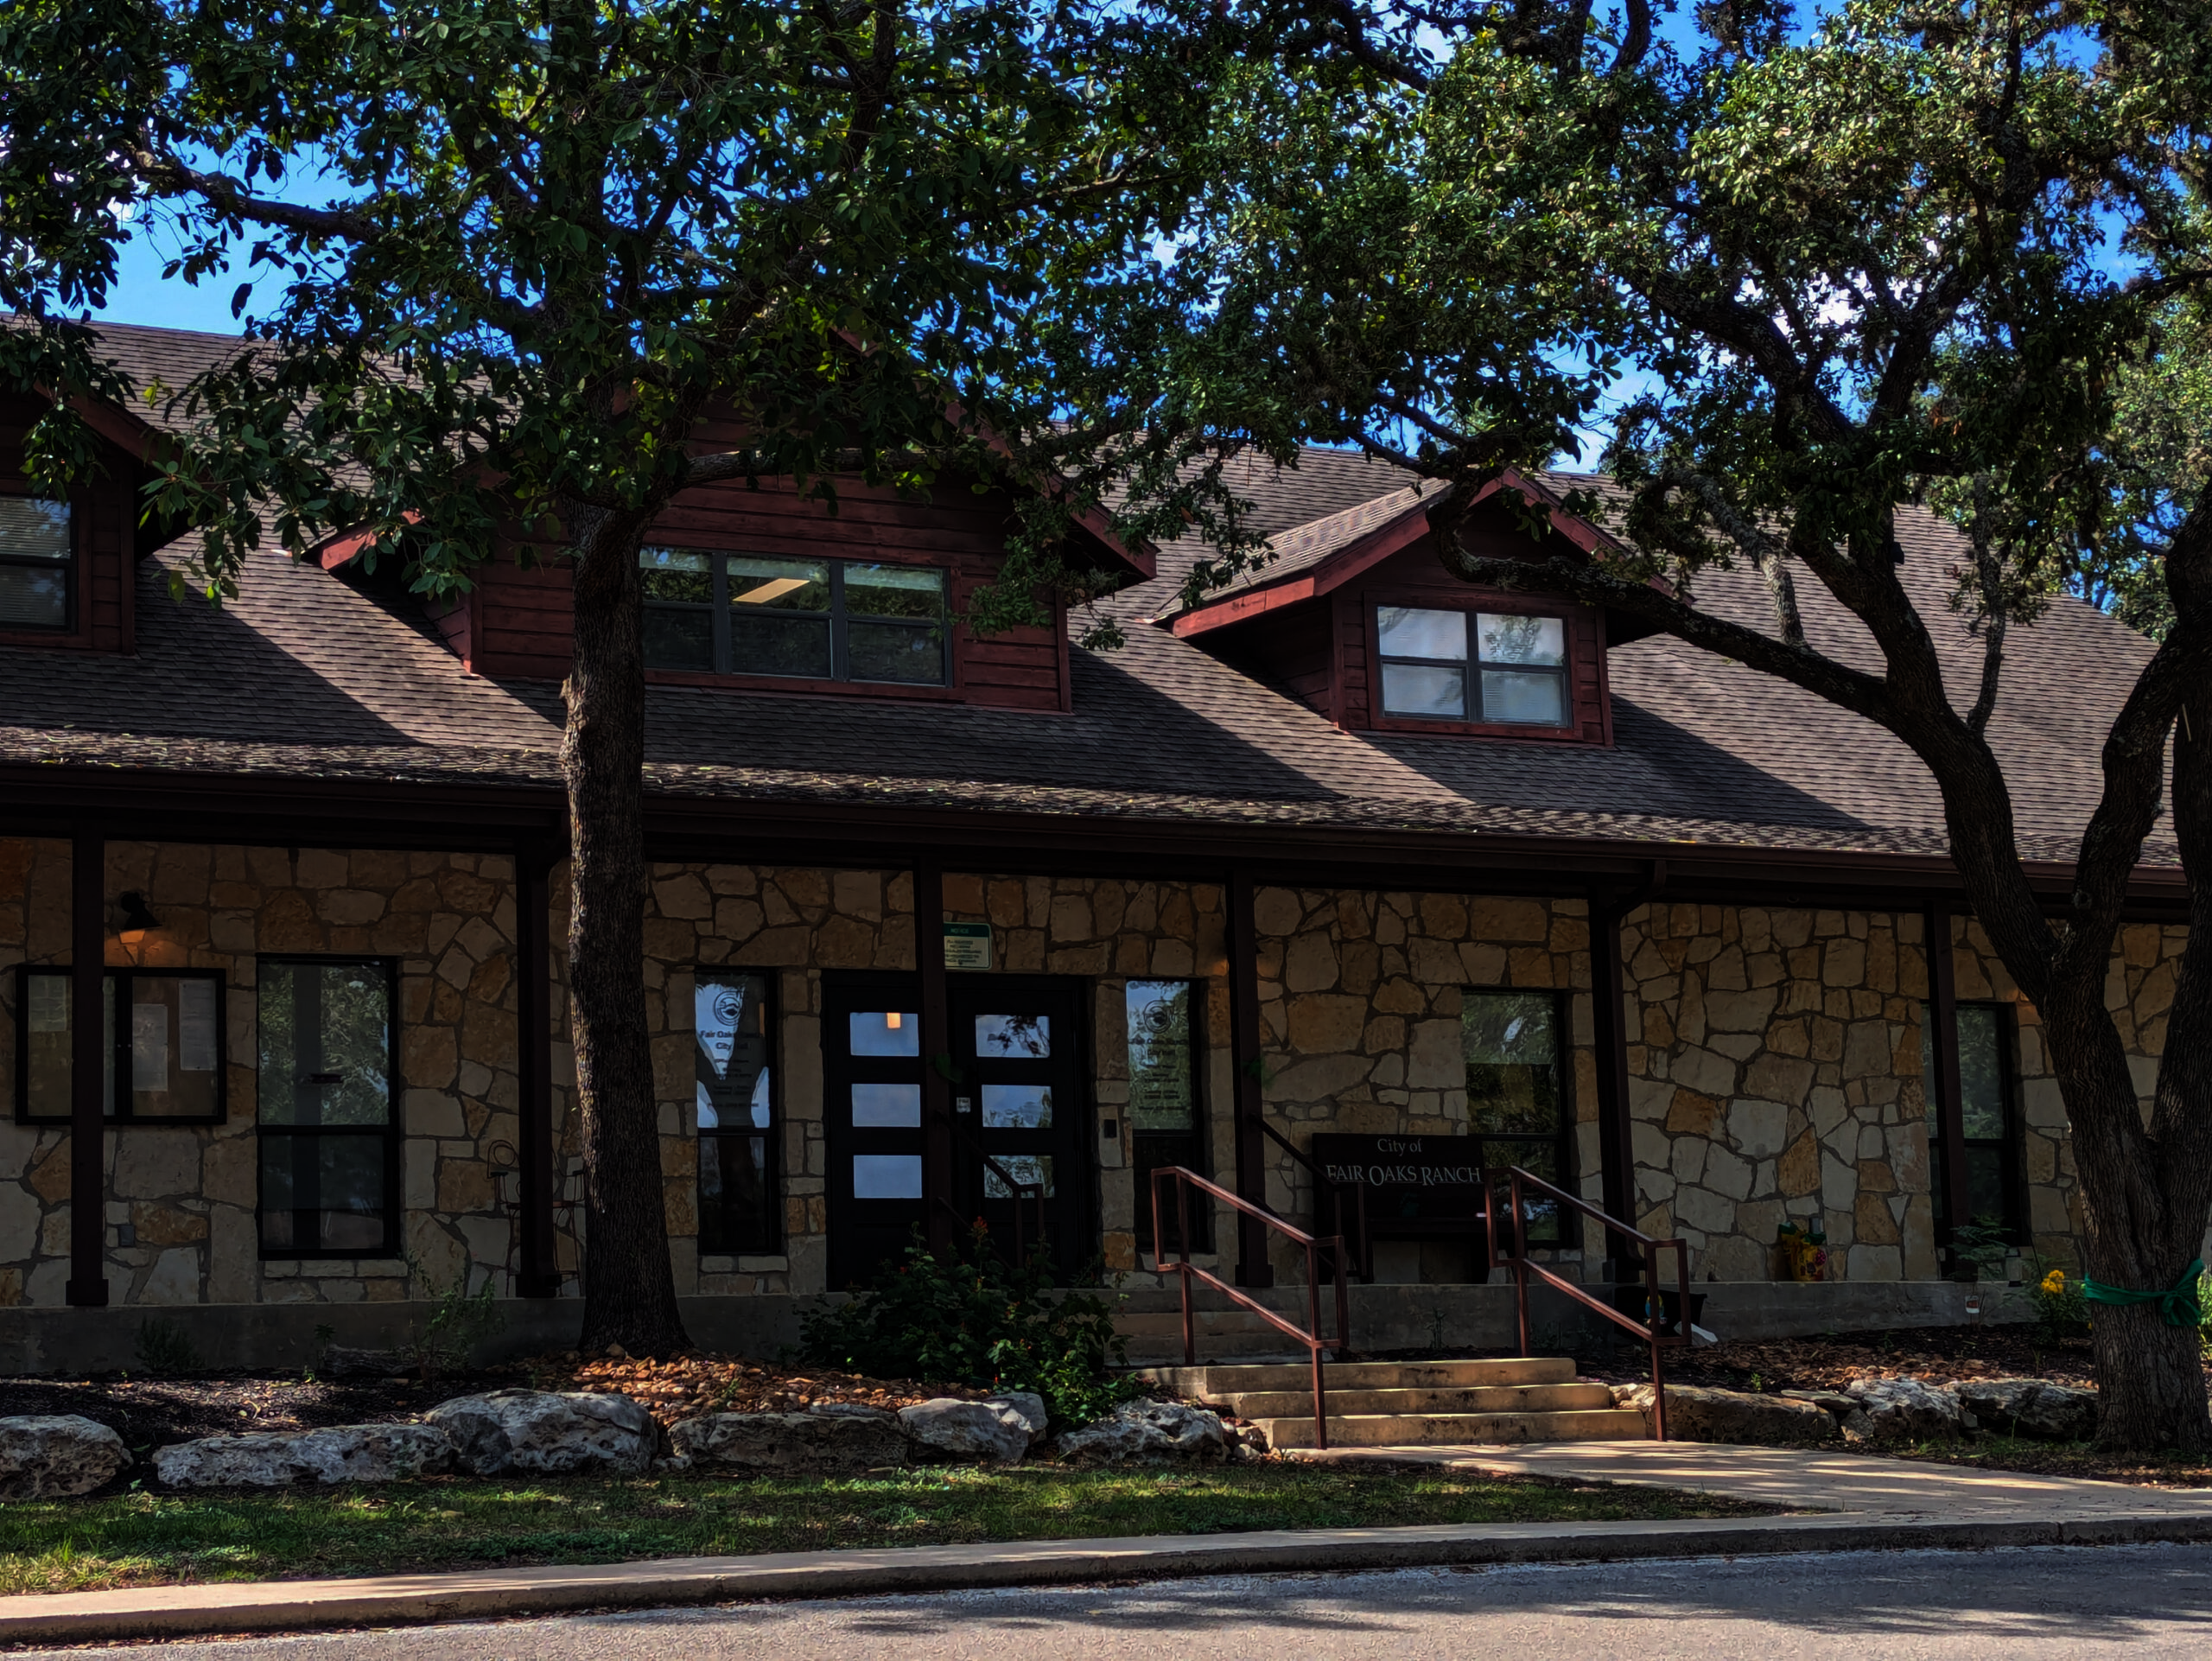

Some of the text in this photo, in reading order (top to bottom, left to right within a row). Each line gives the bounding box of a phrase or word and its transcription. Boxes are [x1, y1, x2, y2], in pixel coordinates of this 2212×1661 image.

[1376, 1137, 1423, 1157] City of
[1326, 1164, 1482, 1187] FAIR OAKS RANCH
